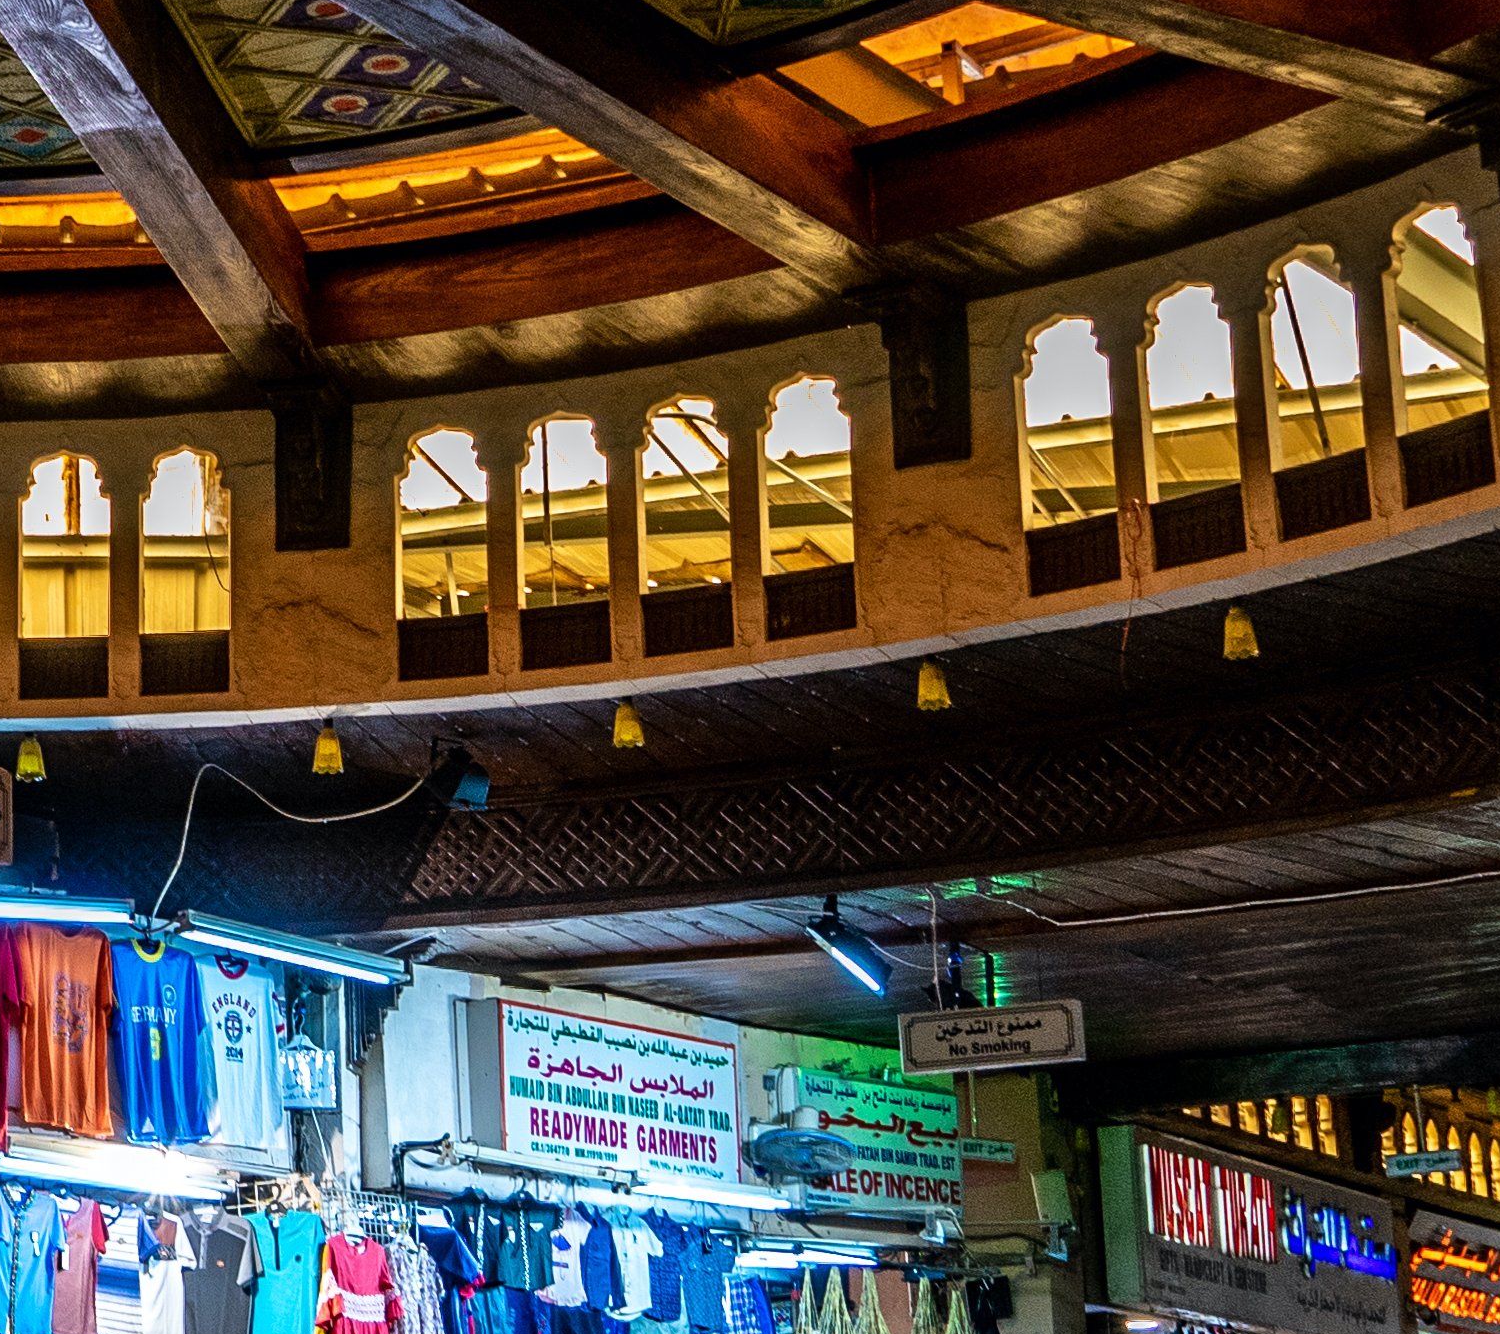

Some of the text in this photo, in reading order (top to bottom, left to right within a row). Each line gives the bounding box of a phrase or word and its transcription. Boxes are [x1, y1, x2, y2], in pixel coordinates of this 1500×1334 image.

[212, 993, 257, 1018] ENGLAND
[507, 1009, 549, 1034] للتجارة
[935, 1017, 1042, 1042] ممنوع التدخين
[949, 1039, 1031, 1056] No Smoking
[527, 1047, 714, 1100] الملابس الجاهزة
[510, 1075, 545, 1100] HUMAID
[547, 1081, 562, 1102] BIN
[565, 1083, 609, 1111] ABDULLAH
[612, 1093, 626, 1114] BIN
[530, 1106, 717, 1164] READYMADE GARMENTS
[818, 1107, 959, 1148] بيع البخو
[881, 1149, 895, 1163] BIN
[859, 1169, 883, 1196] OF
[885, 1172, 961, 1205] INCENCE
